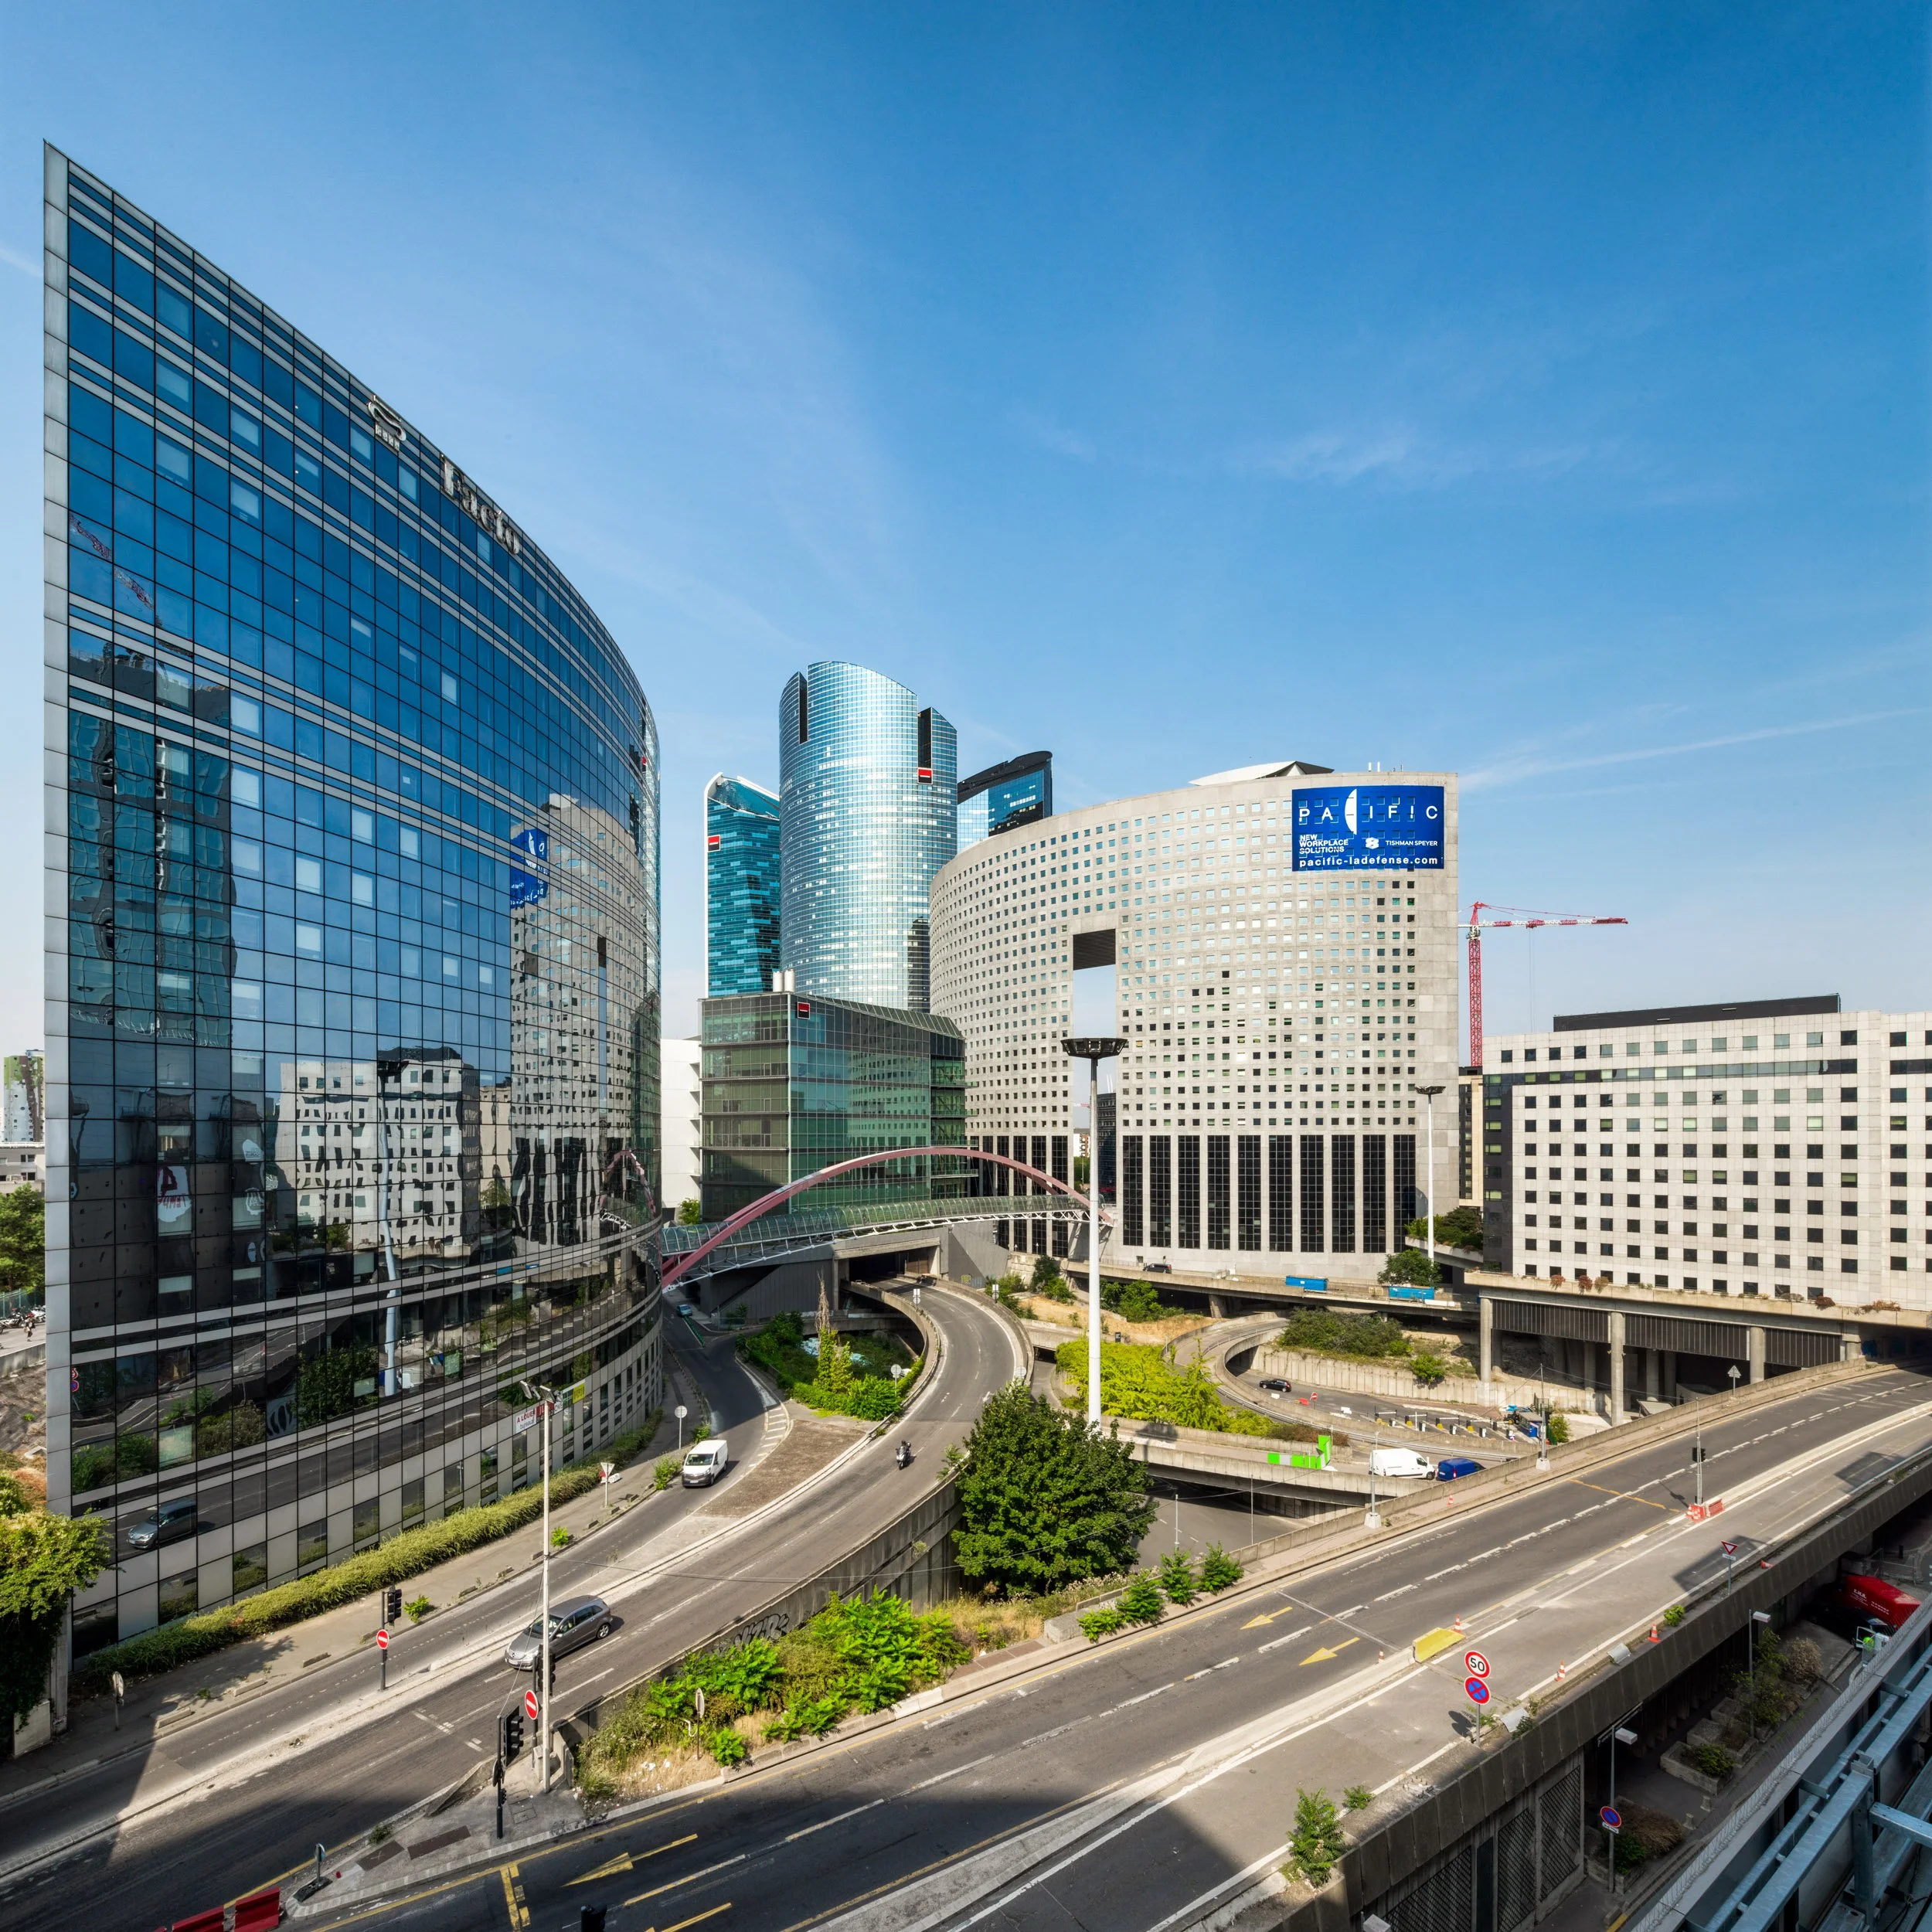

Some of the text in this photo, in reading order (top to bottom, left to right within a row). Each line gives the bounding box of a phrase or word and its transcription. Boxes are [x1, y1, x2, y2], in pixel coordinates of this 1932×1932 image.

[1300, 839, 1349, 848] WORKPLACE
[1299, 856, 1438, 867] pacific-ladefense.com
[1470, 1657, 1485, 1672] 50
